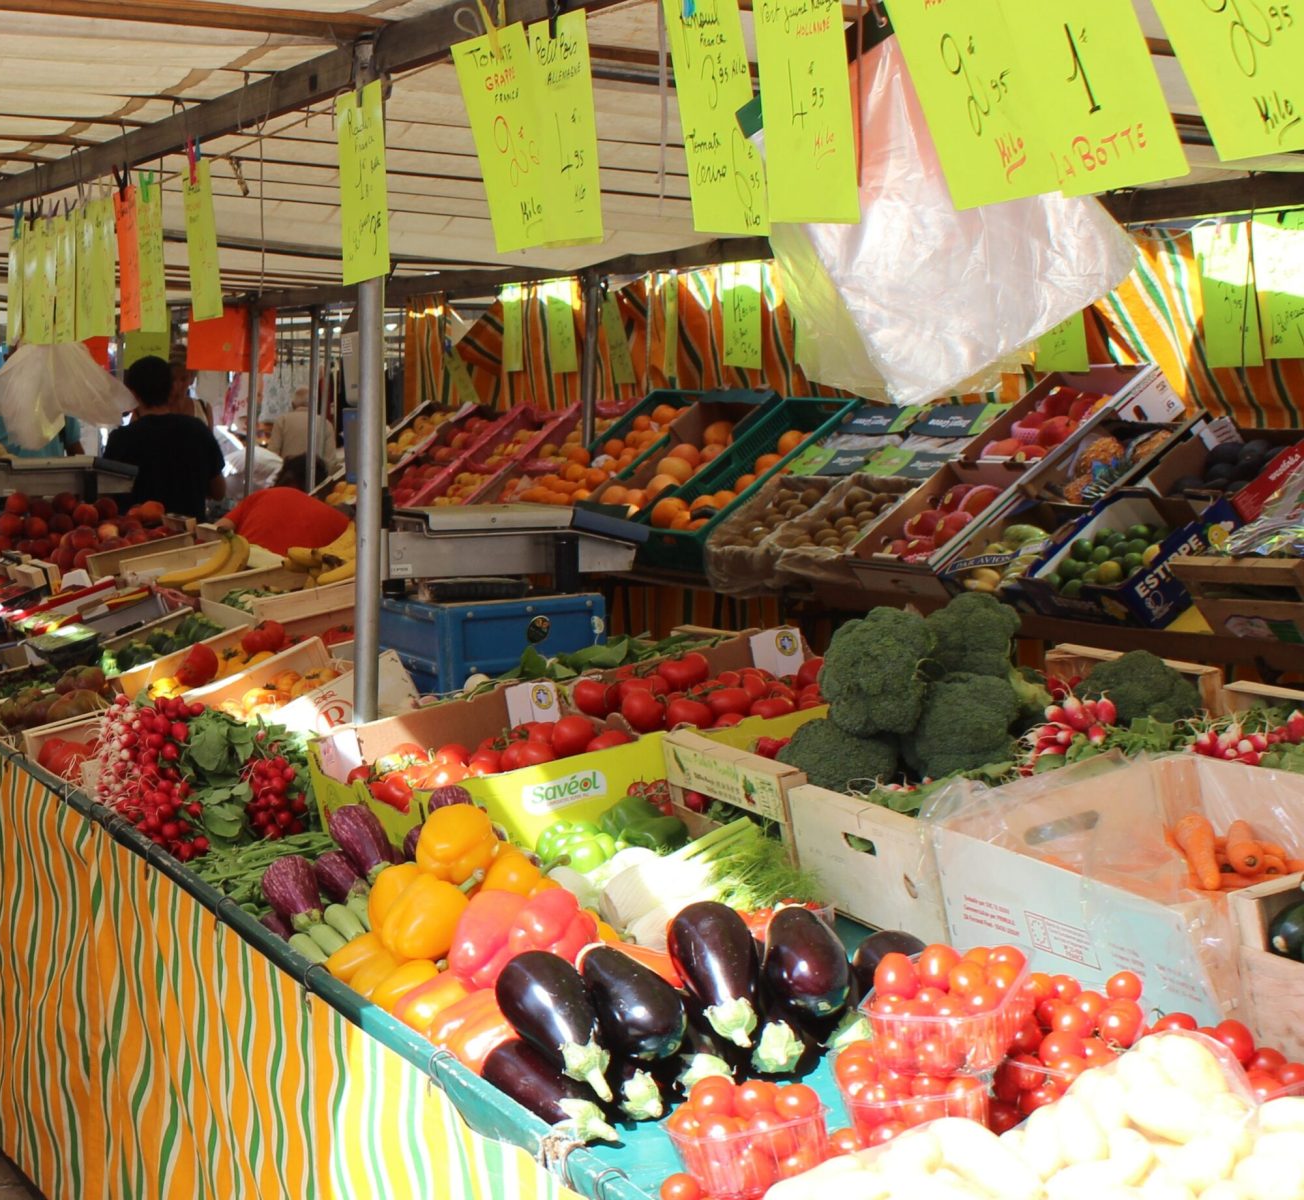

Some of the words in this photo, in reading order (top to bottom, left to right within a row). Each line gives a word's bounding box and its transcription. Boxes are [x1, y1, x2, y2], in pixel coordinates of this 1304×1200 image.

[796, 16, 832, 38] HOLLANDE
[546, 62, 582, 86] ALLEMAGNE
[494, 88, 519, 105] FRANCE
[1252, 90, 1294, 135] Kilo
[995, 131, 1024, 169] Kilo
[1071, 123, 1148, 172] BOTTE
[519, 197, 543, 225] Kilo
[531, 771, 601, 804] Savéol
